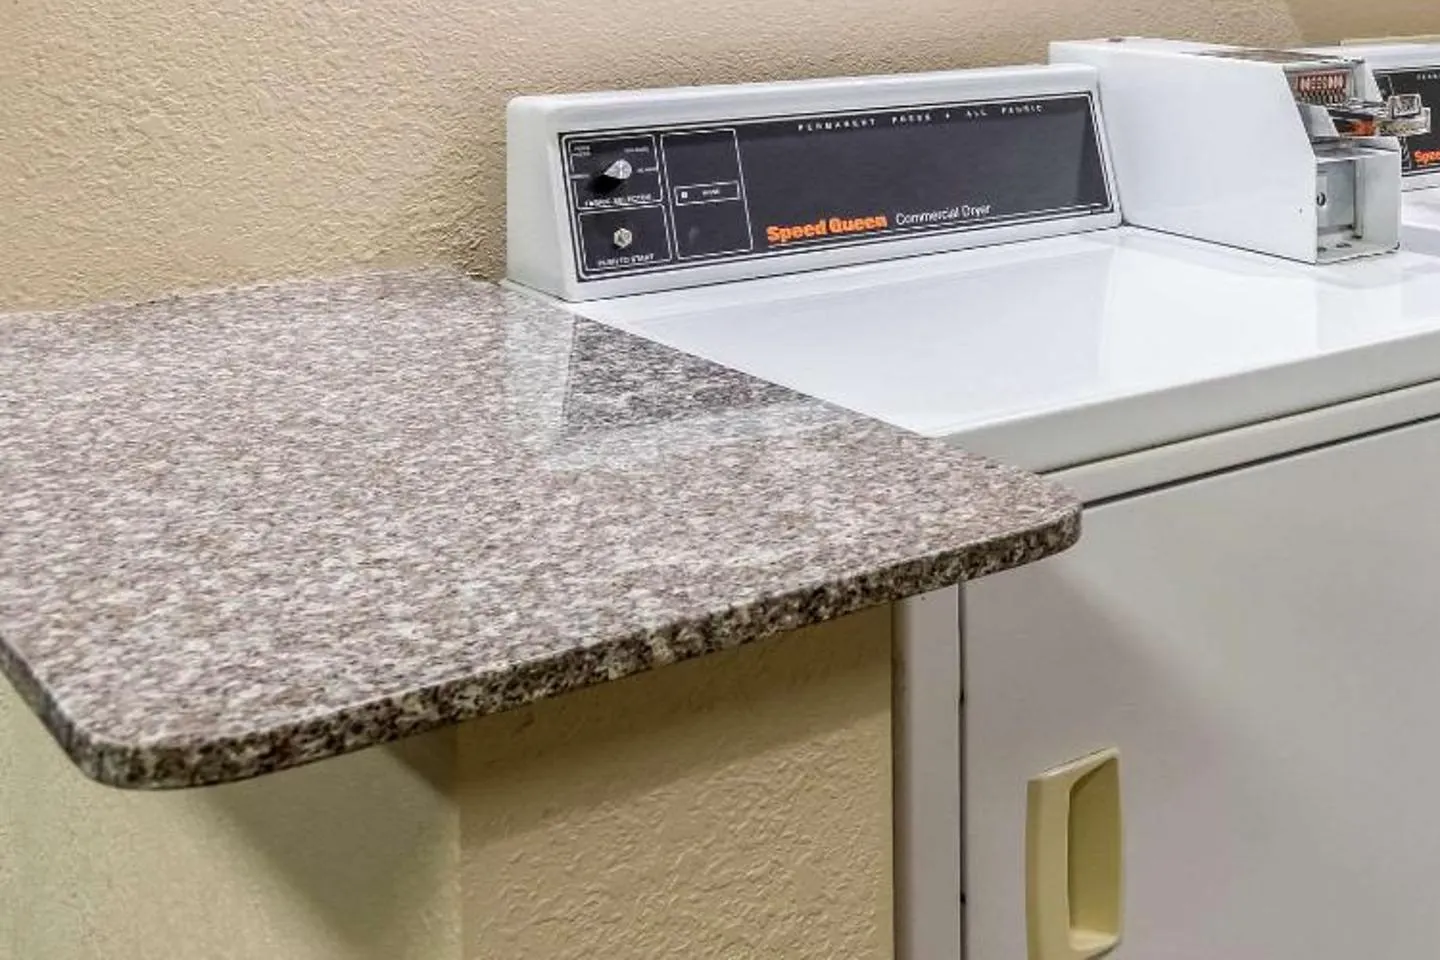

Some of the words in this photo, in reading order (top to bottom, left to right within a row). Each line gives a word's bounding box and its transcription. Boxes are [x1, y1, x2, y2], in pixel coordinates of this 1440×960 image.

[766, 218, 826, 244] Speed
[829, 215, 888, 235] Queen
[896, 206, 959, 225] Commercial
[962, 203, 991, 219] Dryer
